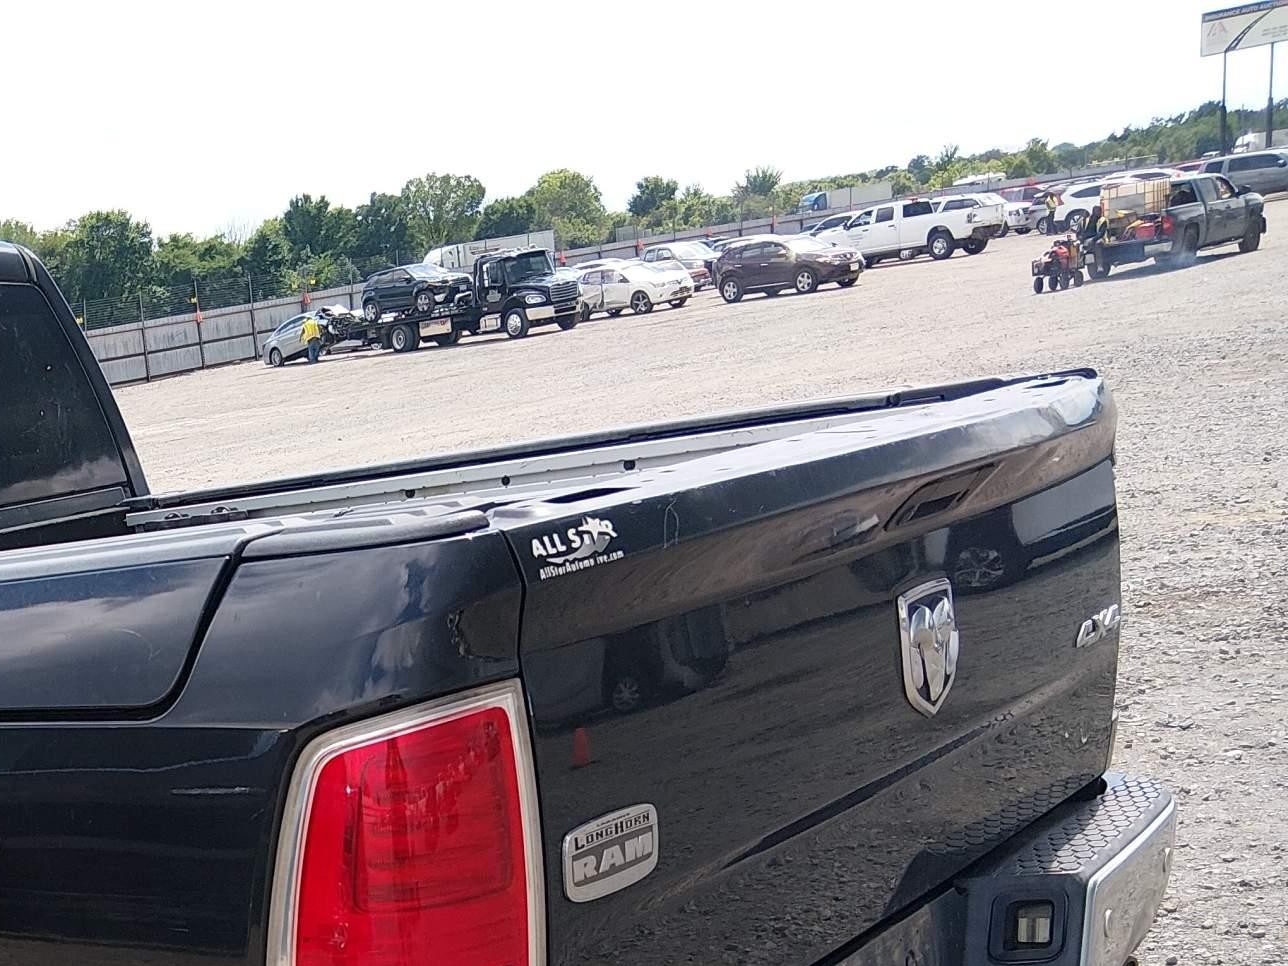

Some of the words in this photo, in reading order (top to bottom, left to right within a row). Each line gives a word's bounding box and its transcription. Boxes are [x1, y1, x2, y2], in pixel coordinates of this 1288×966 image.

[532, 533, 567, 558] ALL
[567, 516, 618, 548] STR
[539, 550, 625, 581] AllStarAutomoive.com
[572, 831, 654, 884] RAM
